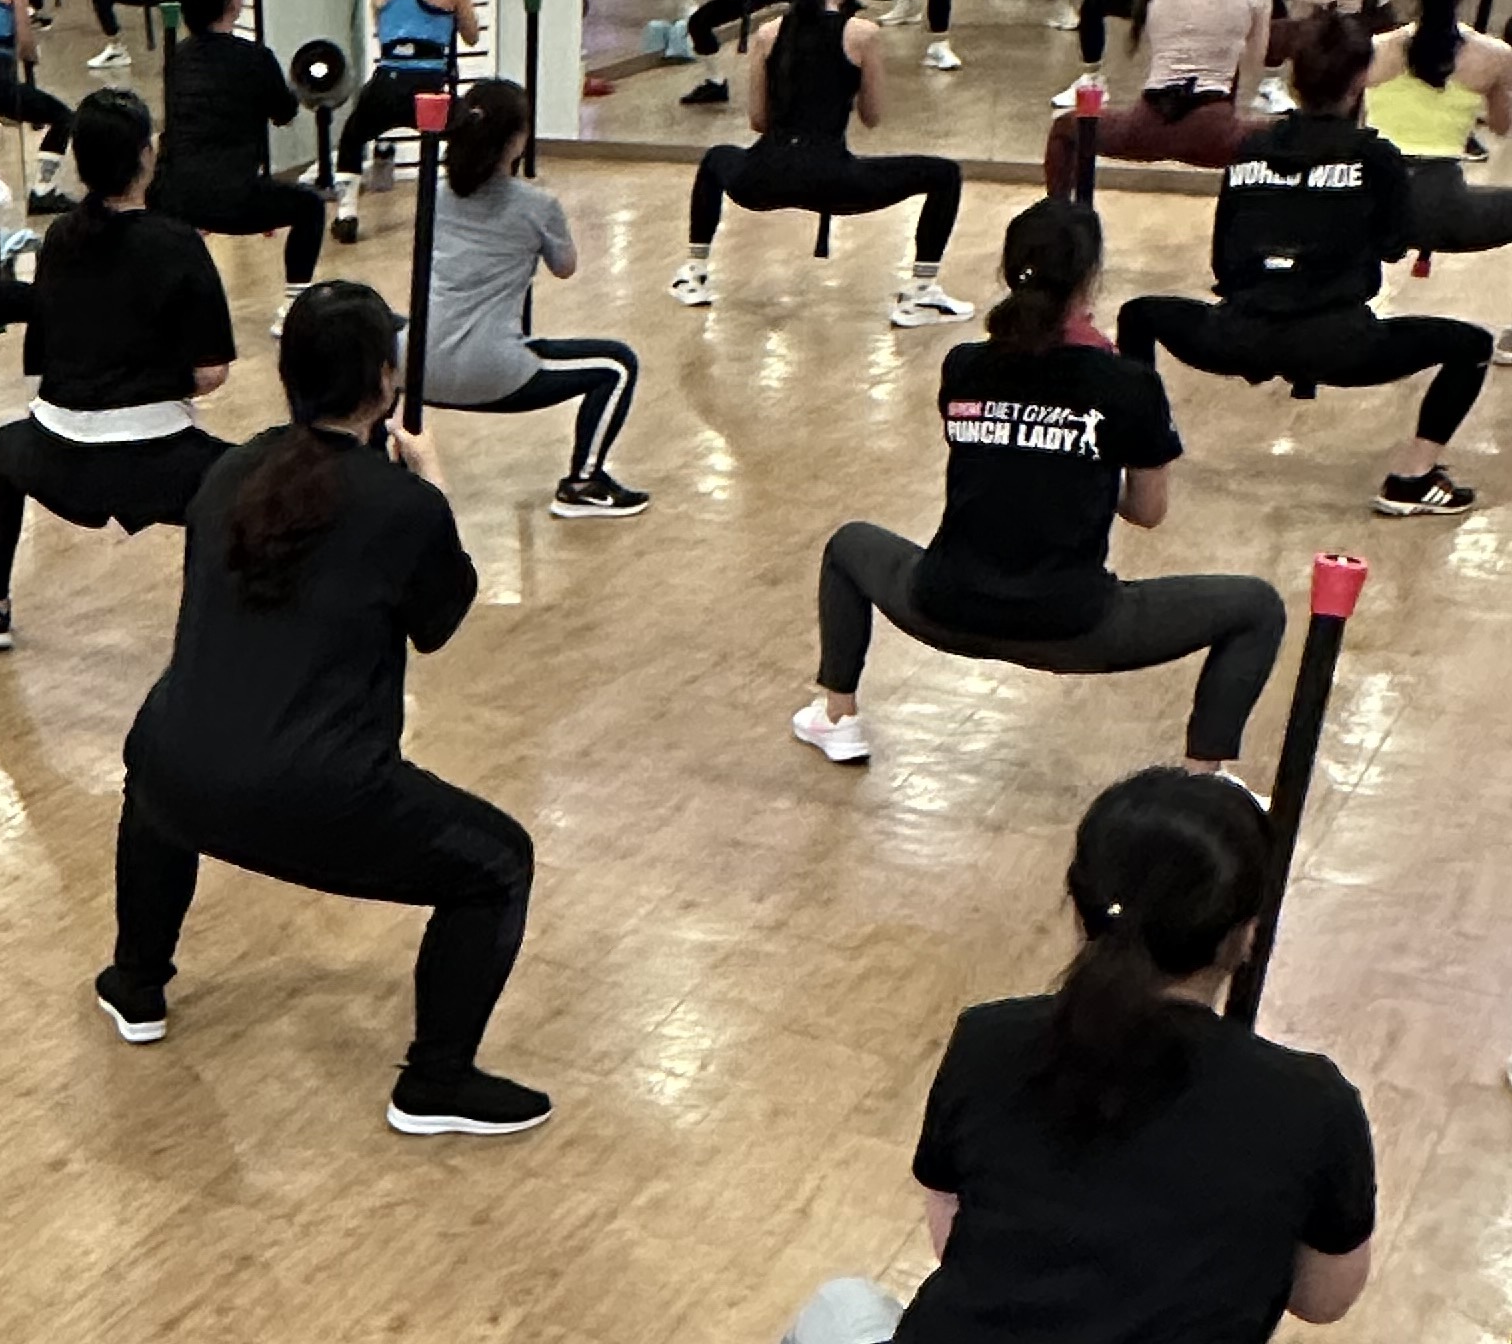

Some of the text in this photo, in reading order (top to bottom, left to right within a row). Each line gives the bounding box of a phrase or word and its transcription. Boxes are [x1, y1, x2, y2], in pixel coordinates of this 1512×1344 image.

[1307, 162, 1363, 188] WIDE
[985, 400, 1023, 421] DIET
[947, 420, 1079, 452] PUNCH LADY
